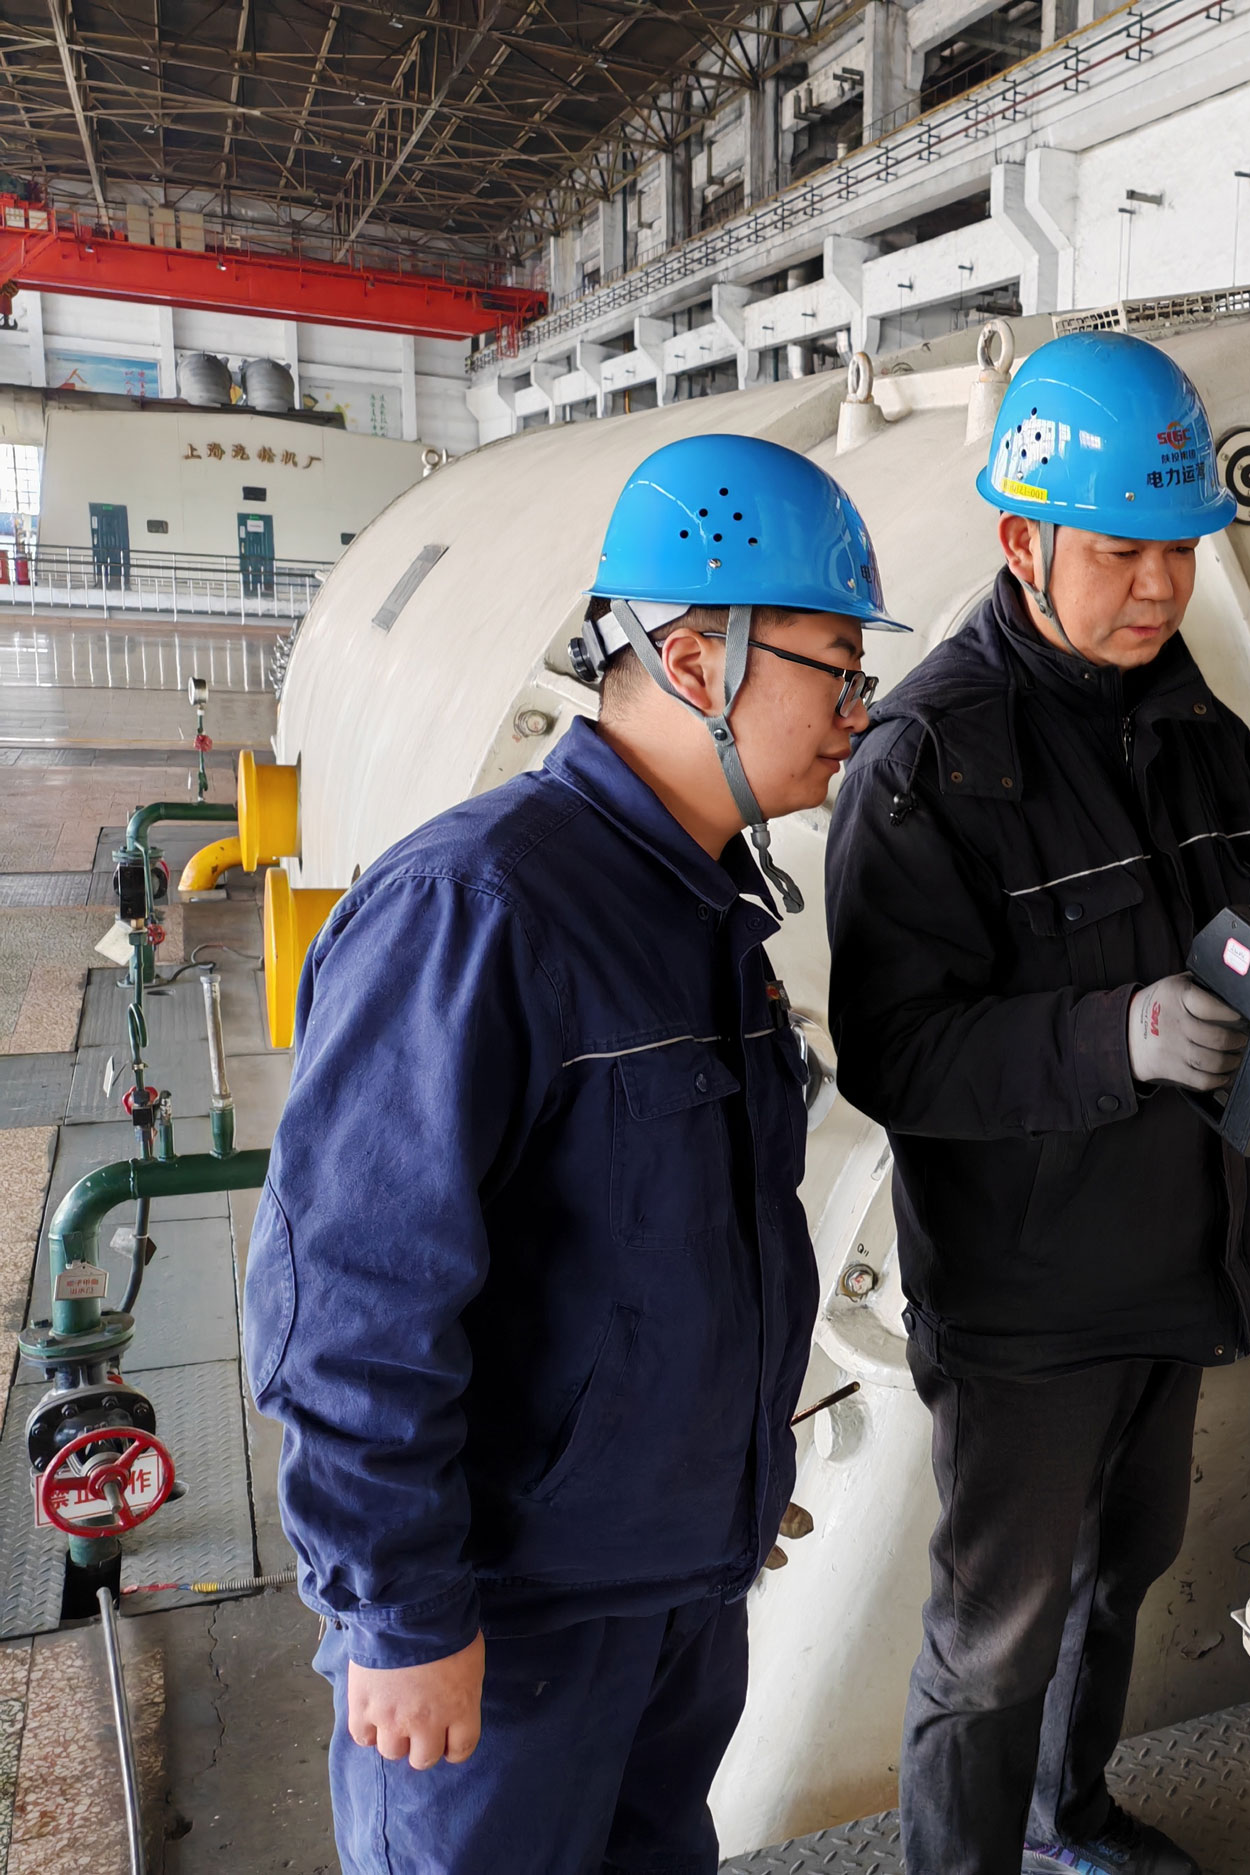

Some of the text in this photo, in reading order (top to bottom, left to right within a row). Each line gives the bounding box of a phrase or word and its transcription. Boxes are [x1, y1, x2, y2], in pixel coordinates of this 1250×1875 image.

[183, 442, 322, 470] 上海汽轮机厂
[50, 1468, 152, 1511] 禁止作
